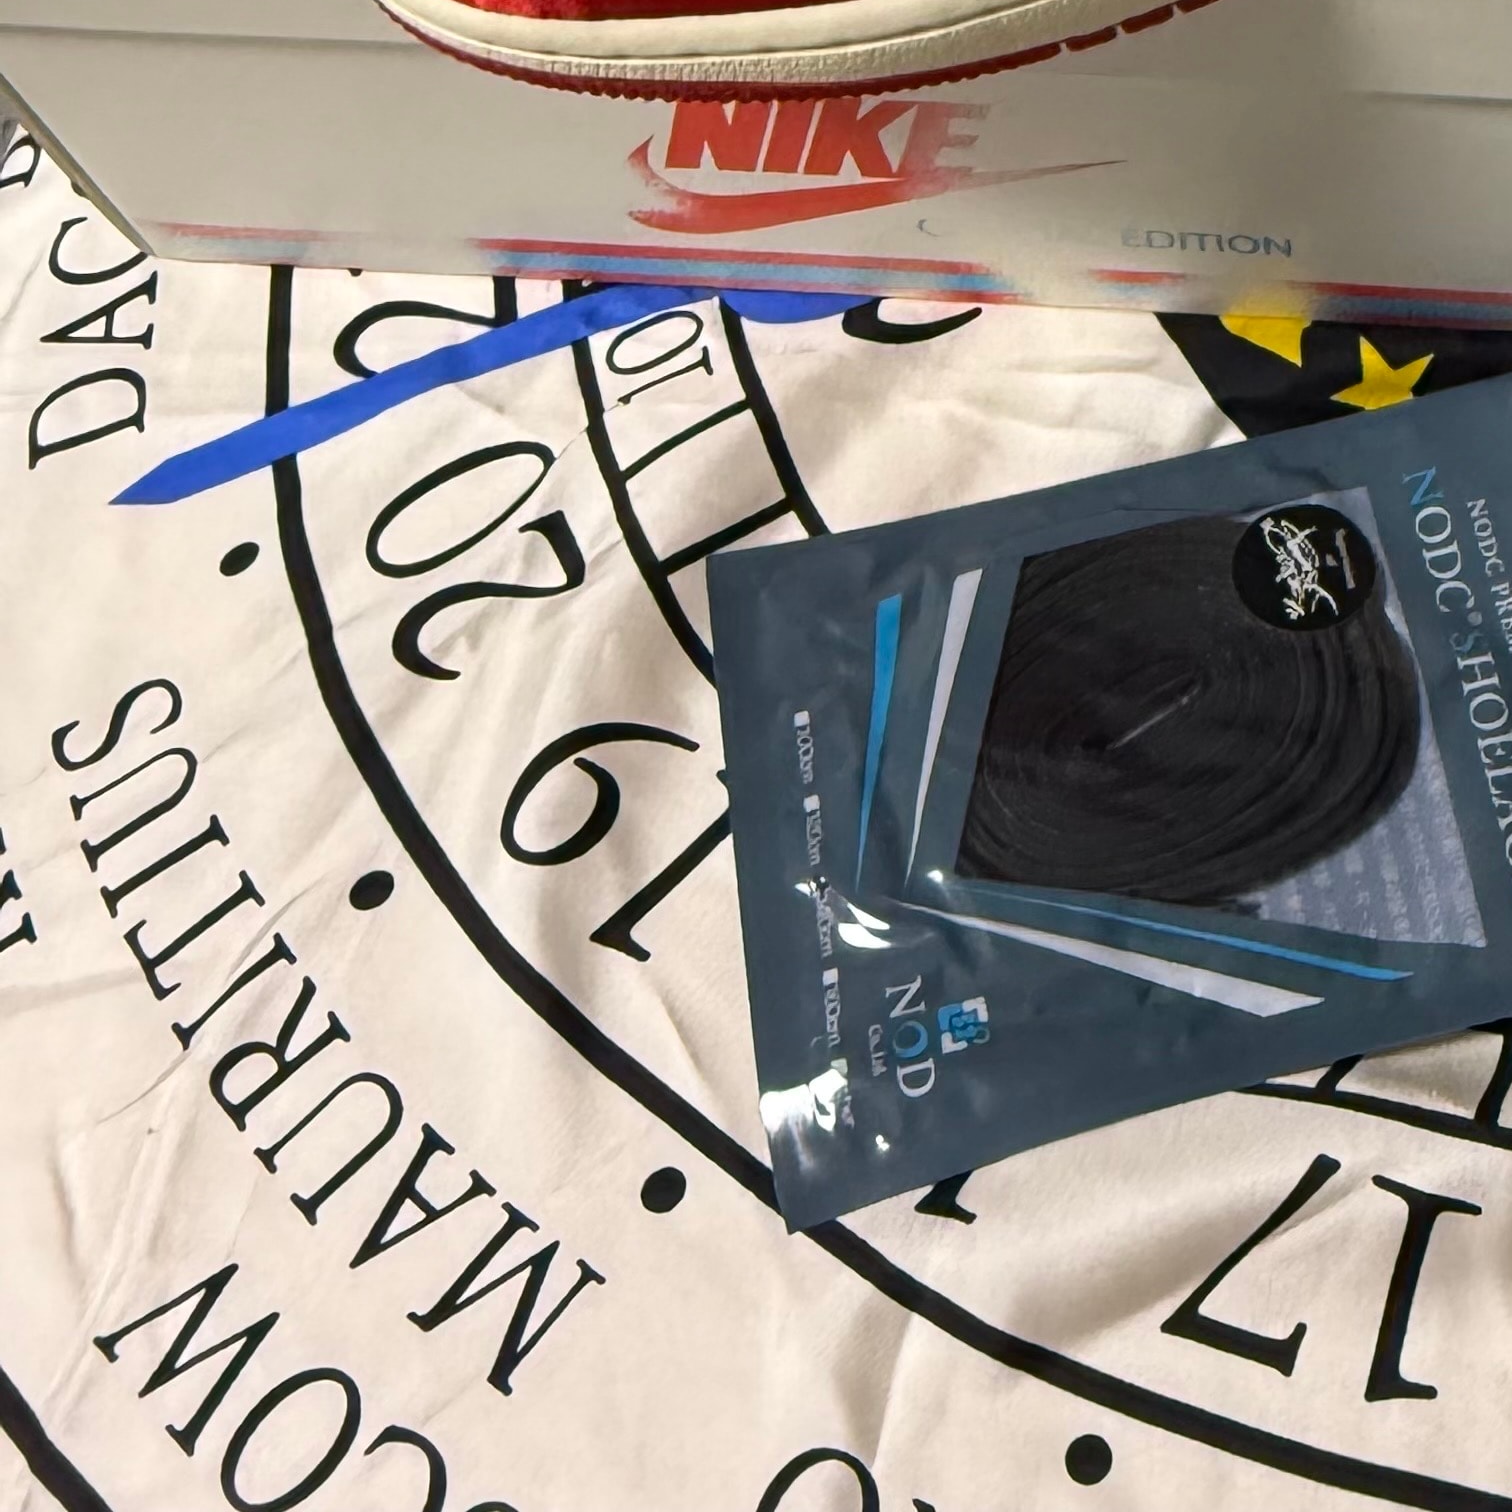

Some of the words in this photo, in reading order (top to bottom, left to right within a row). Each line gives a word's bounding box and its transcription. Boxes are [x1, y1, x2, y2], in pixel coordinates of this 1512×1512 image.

[665, 98, 992, 180] NIKE
[1120, 228, 1293, 258] EDITION
[29, 215, 157, 471] DAC
[605, 309, 714, 406] 10
[366, 441, 586, 681] 20
[1466, 497, 1506, 579] NODC
[500, 721, 735, 962] 19
[51, 678, 606, 1397] MAURITIUS
[885, 974, 936, 1098] NOD
[1160, 1153, 1483, 1403] 17
